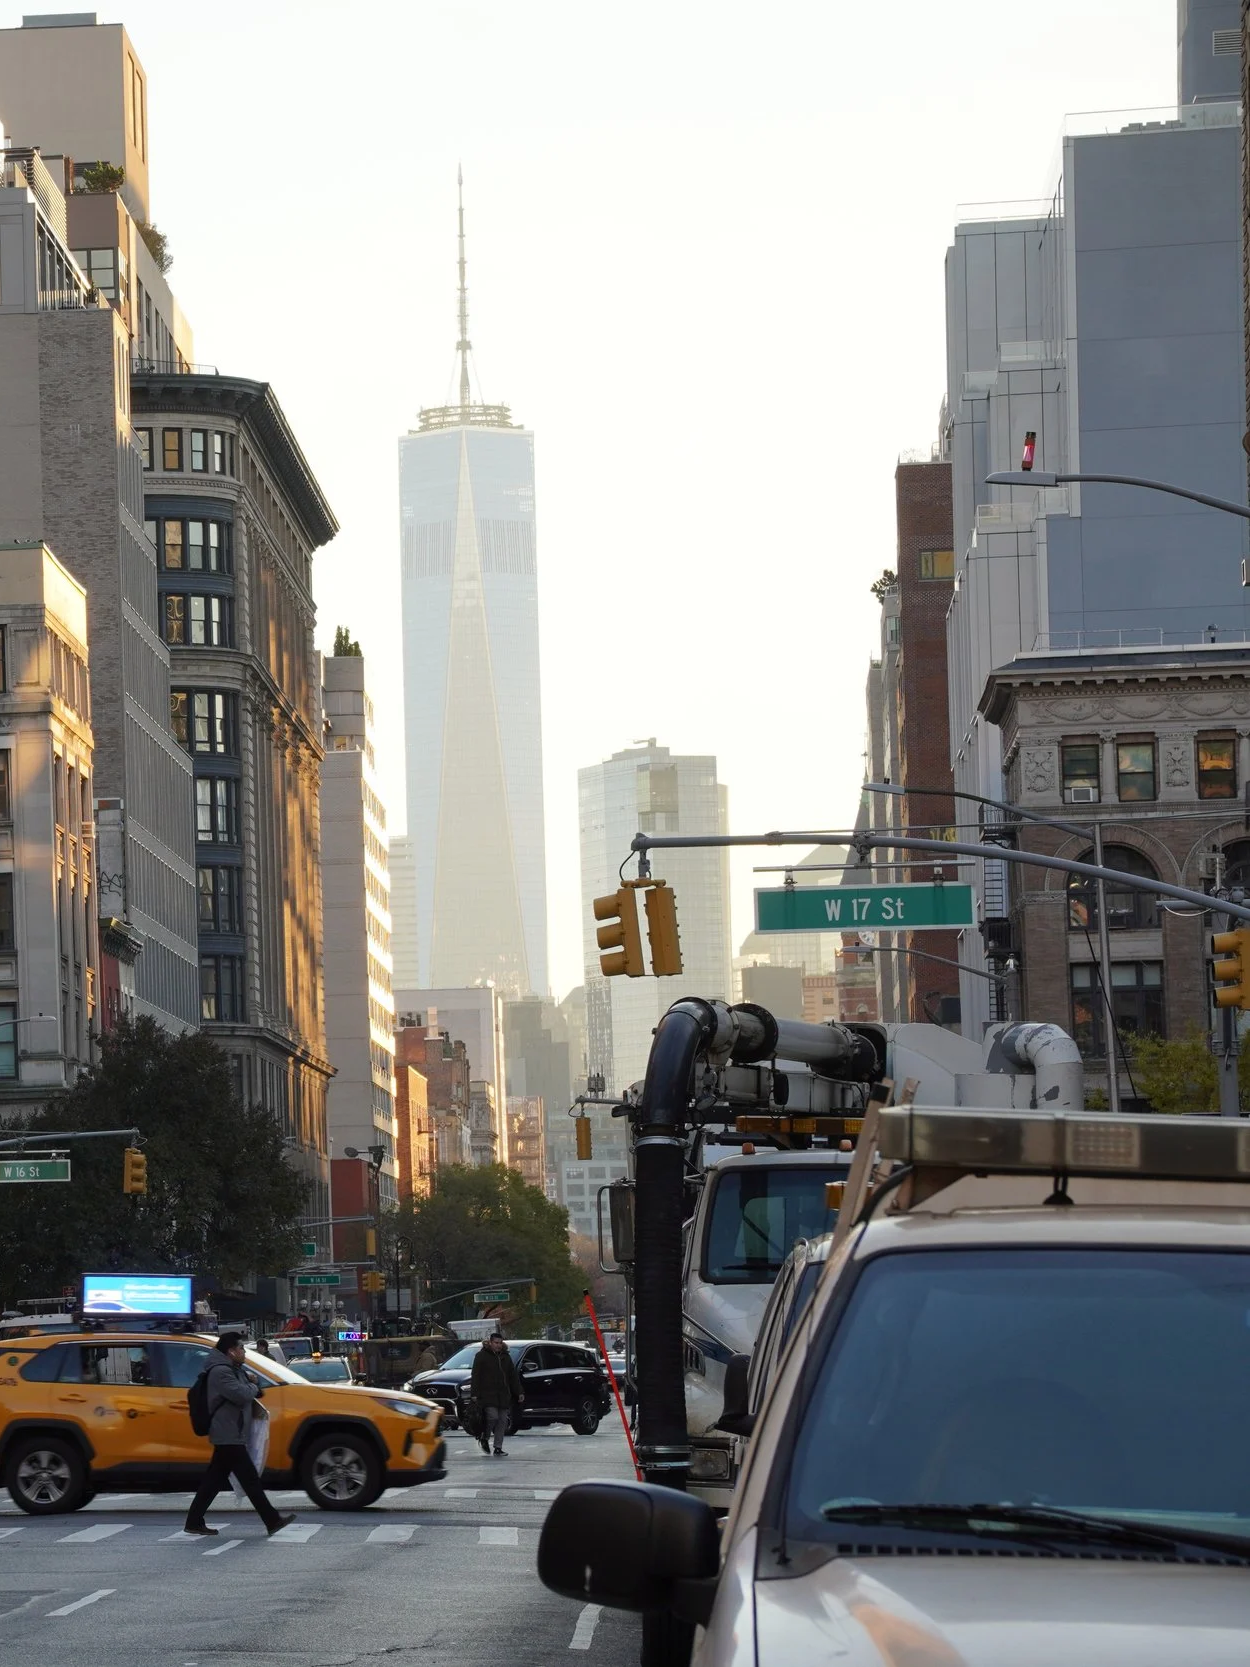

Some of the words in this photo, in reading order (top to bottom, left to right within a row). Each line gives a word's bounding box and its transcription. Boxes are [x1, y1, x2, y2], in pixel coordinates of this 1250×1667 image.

[824, 899, 842, 921] W
[852, 898, 871, 920] 17
[881, 897, 904, 920] St
[4, 1167, 12, 1177] W
[16, 1167, 25, 1177] 16
[29, 1166, 39, 1177] St
